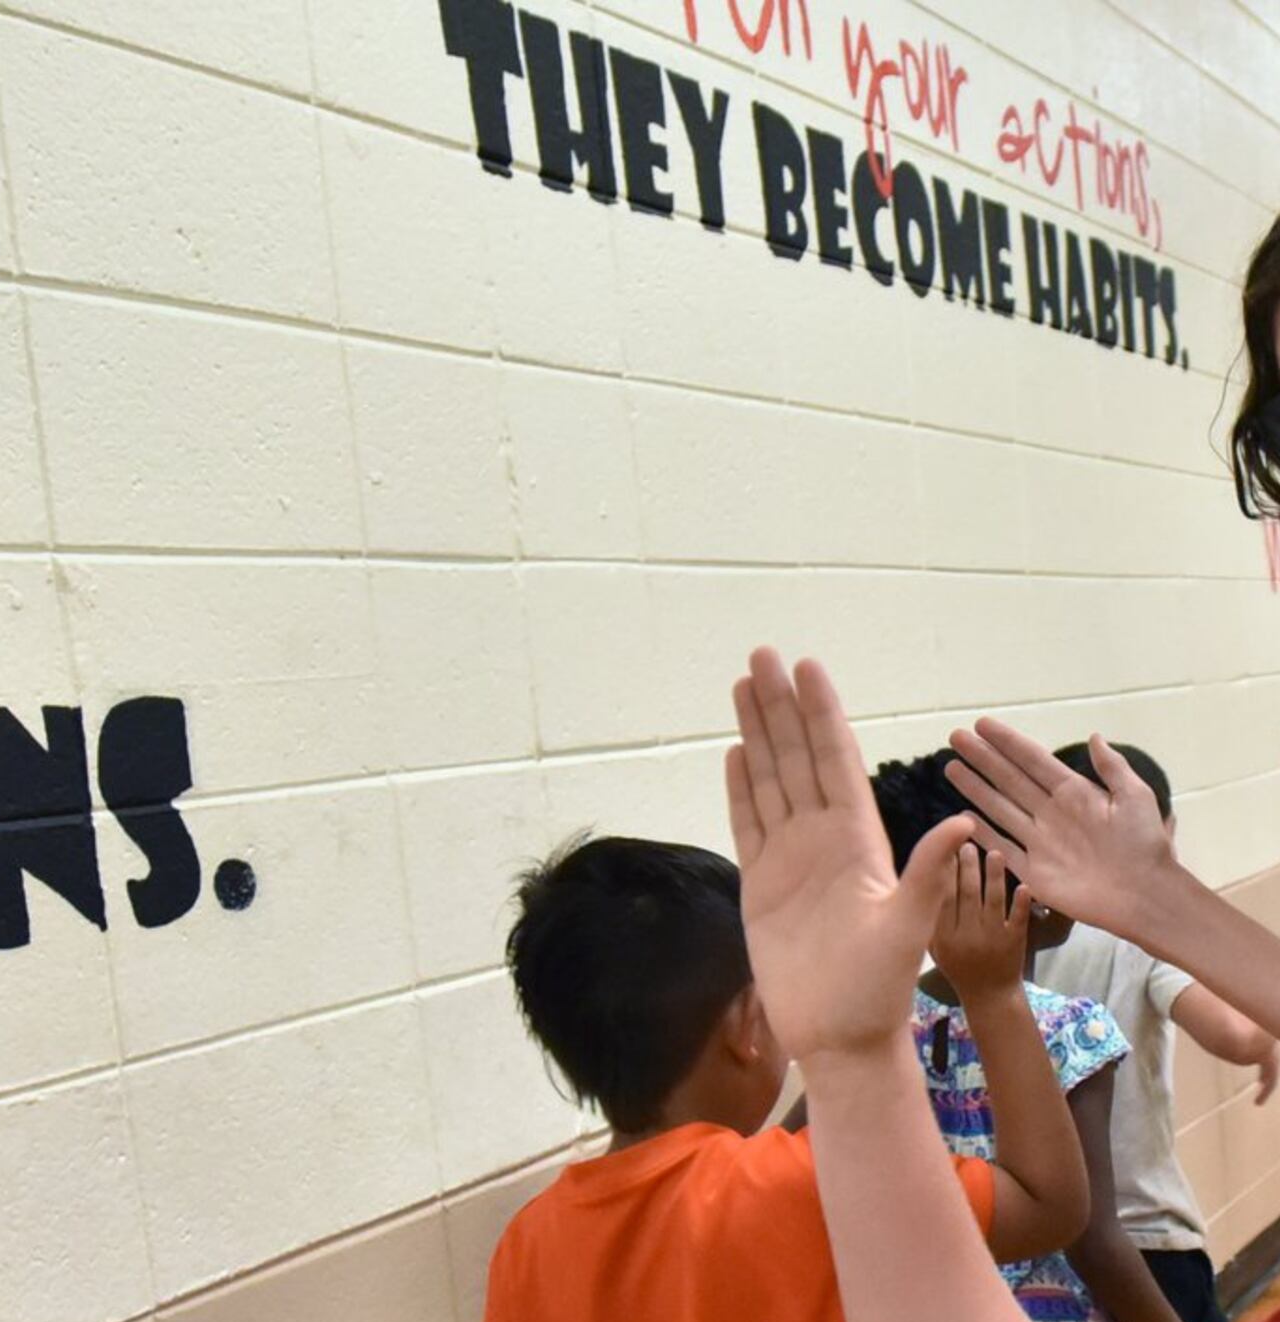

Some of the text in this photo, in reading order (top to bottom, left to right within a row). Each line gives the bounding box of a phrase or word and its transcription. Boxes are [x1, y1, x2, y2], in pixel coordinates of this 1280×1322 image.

[438, 0, 1190, 371] THEY BECOME HABITS.
[841, 14, 1163, 252] your actions,
